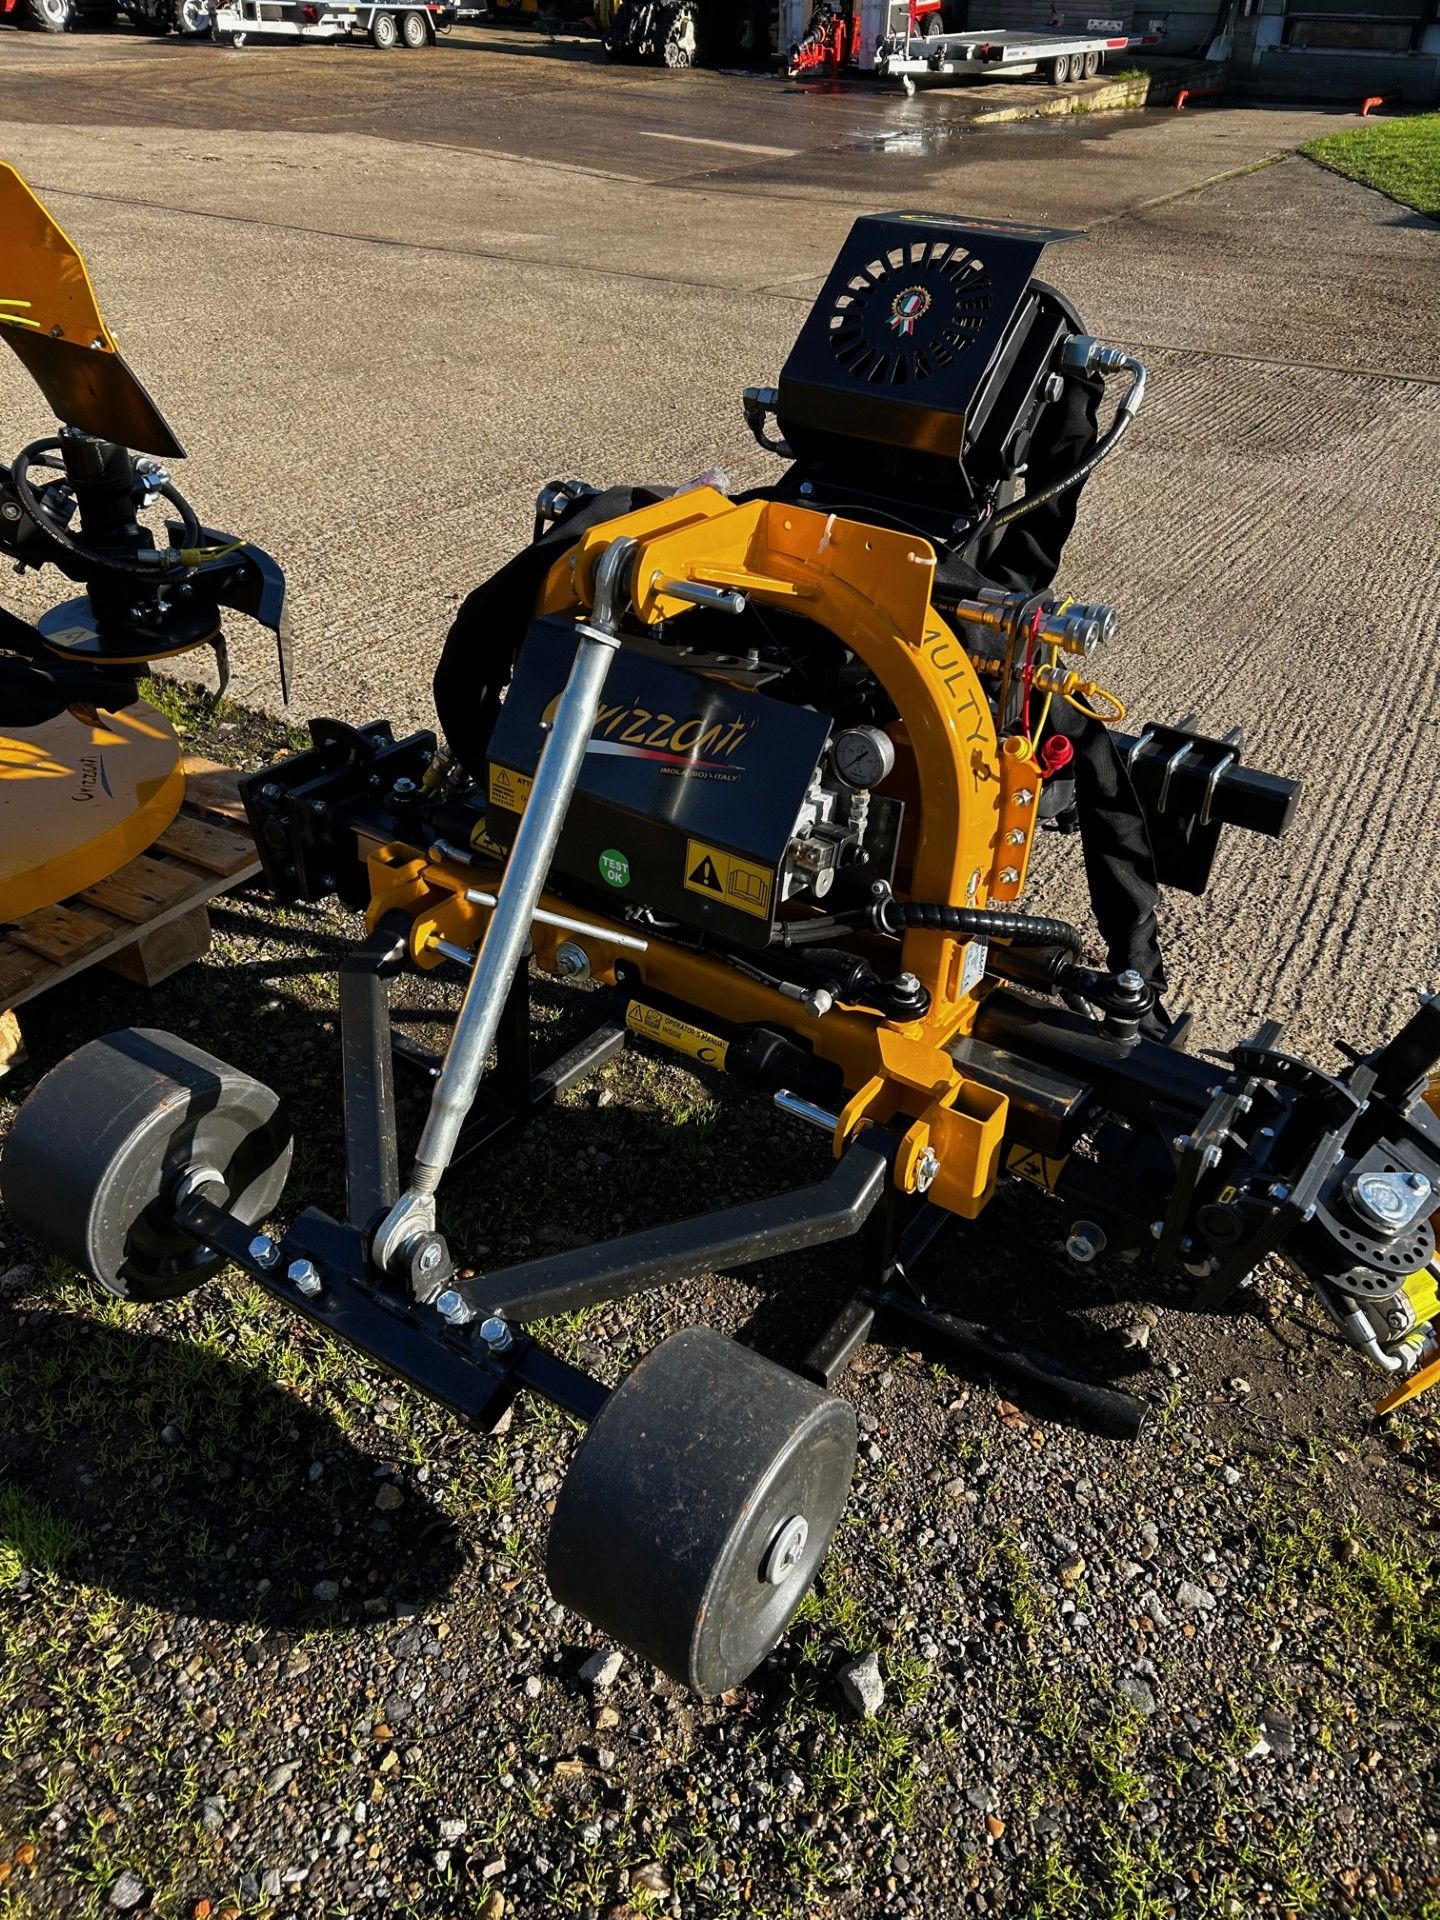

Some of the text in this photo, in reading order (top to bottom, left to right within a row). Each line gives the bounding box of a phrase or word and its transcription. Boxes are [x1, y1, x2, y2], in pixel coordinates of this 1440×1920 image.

[714, 773, 738, 782] ITALY
[602, 855, 629, 874] TEST
[607, 869, 623, 884] OK
[701, 1033, 727, 1050] MANUAL
